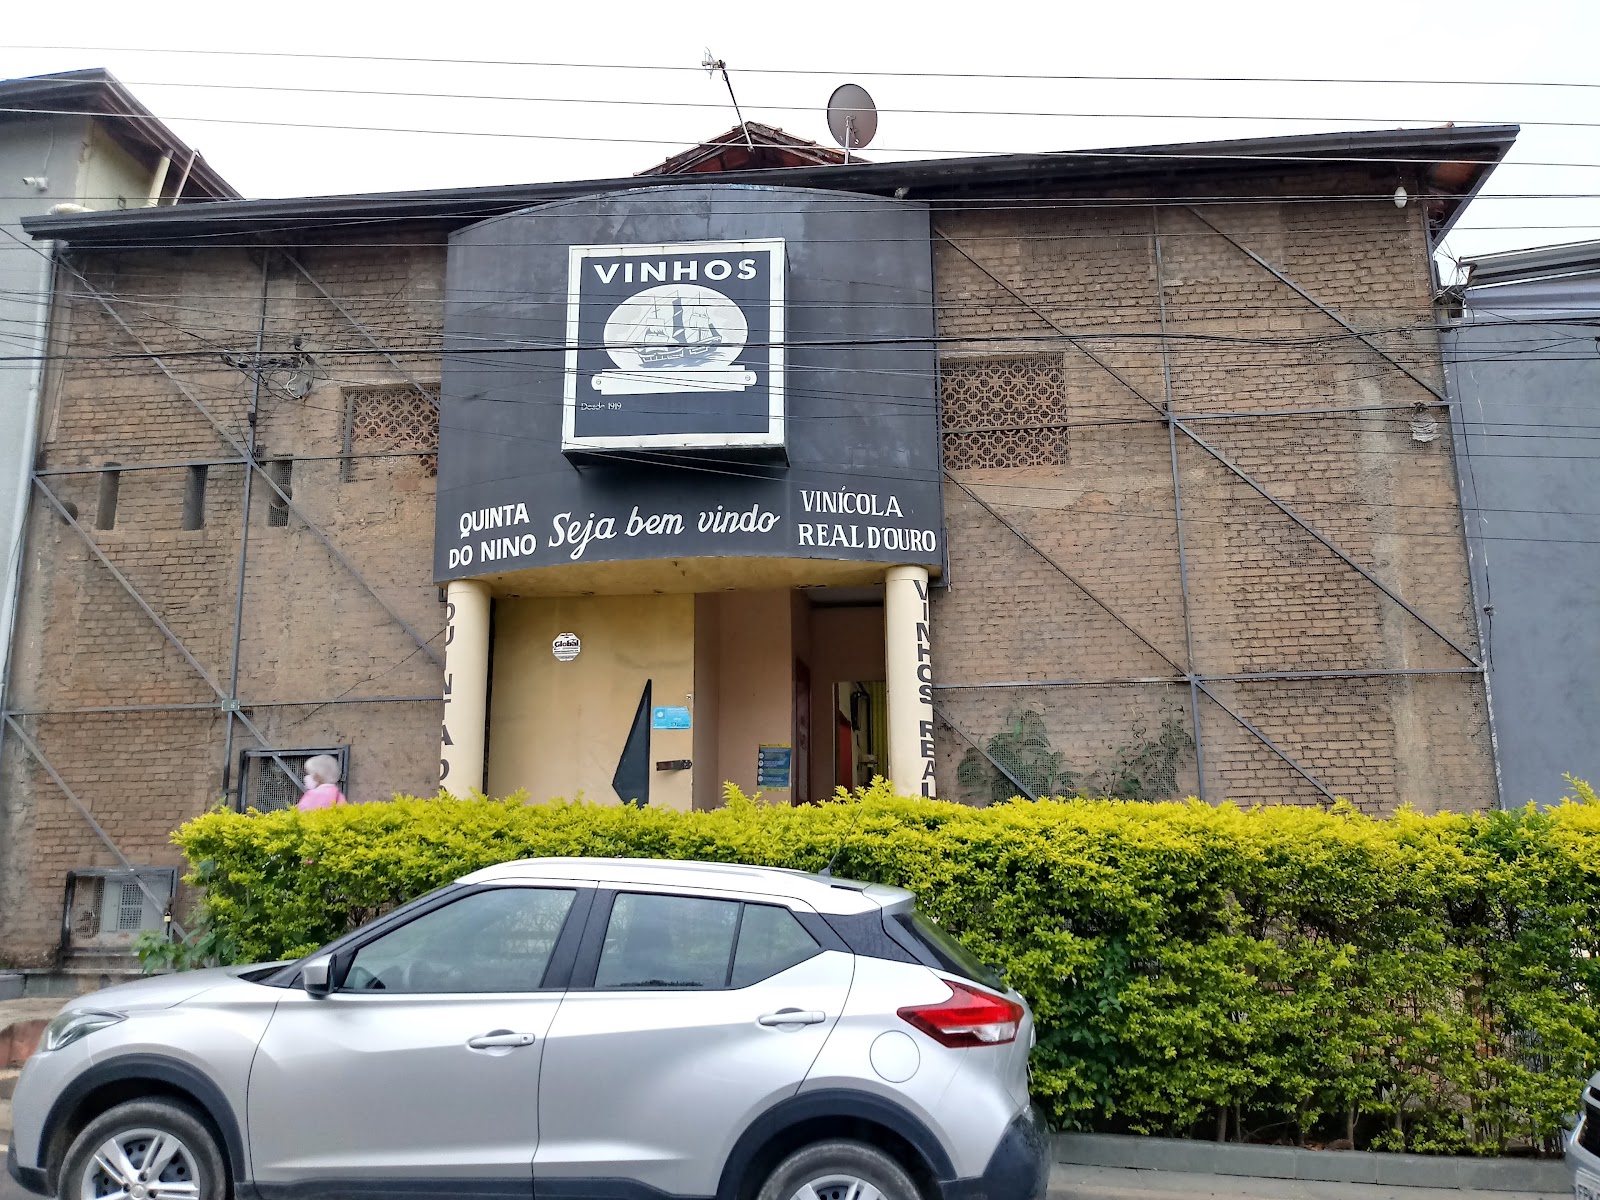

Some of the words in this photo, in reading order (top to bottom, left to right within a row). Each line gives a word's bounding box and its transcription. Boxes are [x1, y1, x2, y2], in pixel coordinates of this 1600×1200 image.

[593, 259, 757, 284] VINHOS
[799, 485, 904, 518] VINÍCOLA
[459, 502, 530, 539] QUINTA
[548, 511, 618, 560] Seja
[624, 506, 685, 537] bem
[697, 503, 781, 533] vindo
[798, 523, 864, 549] REAL
[448, 545, 473, 569] DO
[480, 533, 537, 562] NINO
[554, 639, 579, 647] Global
[913, 580, 933, 704] VINHOS
